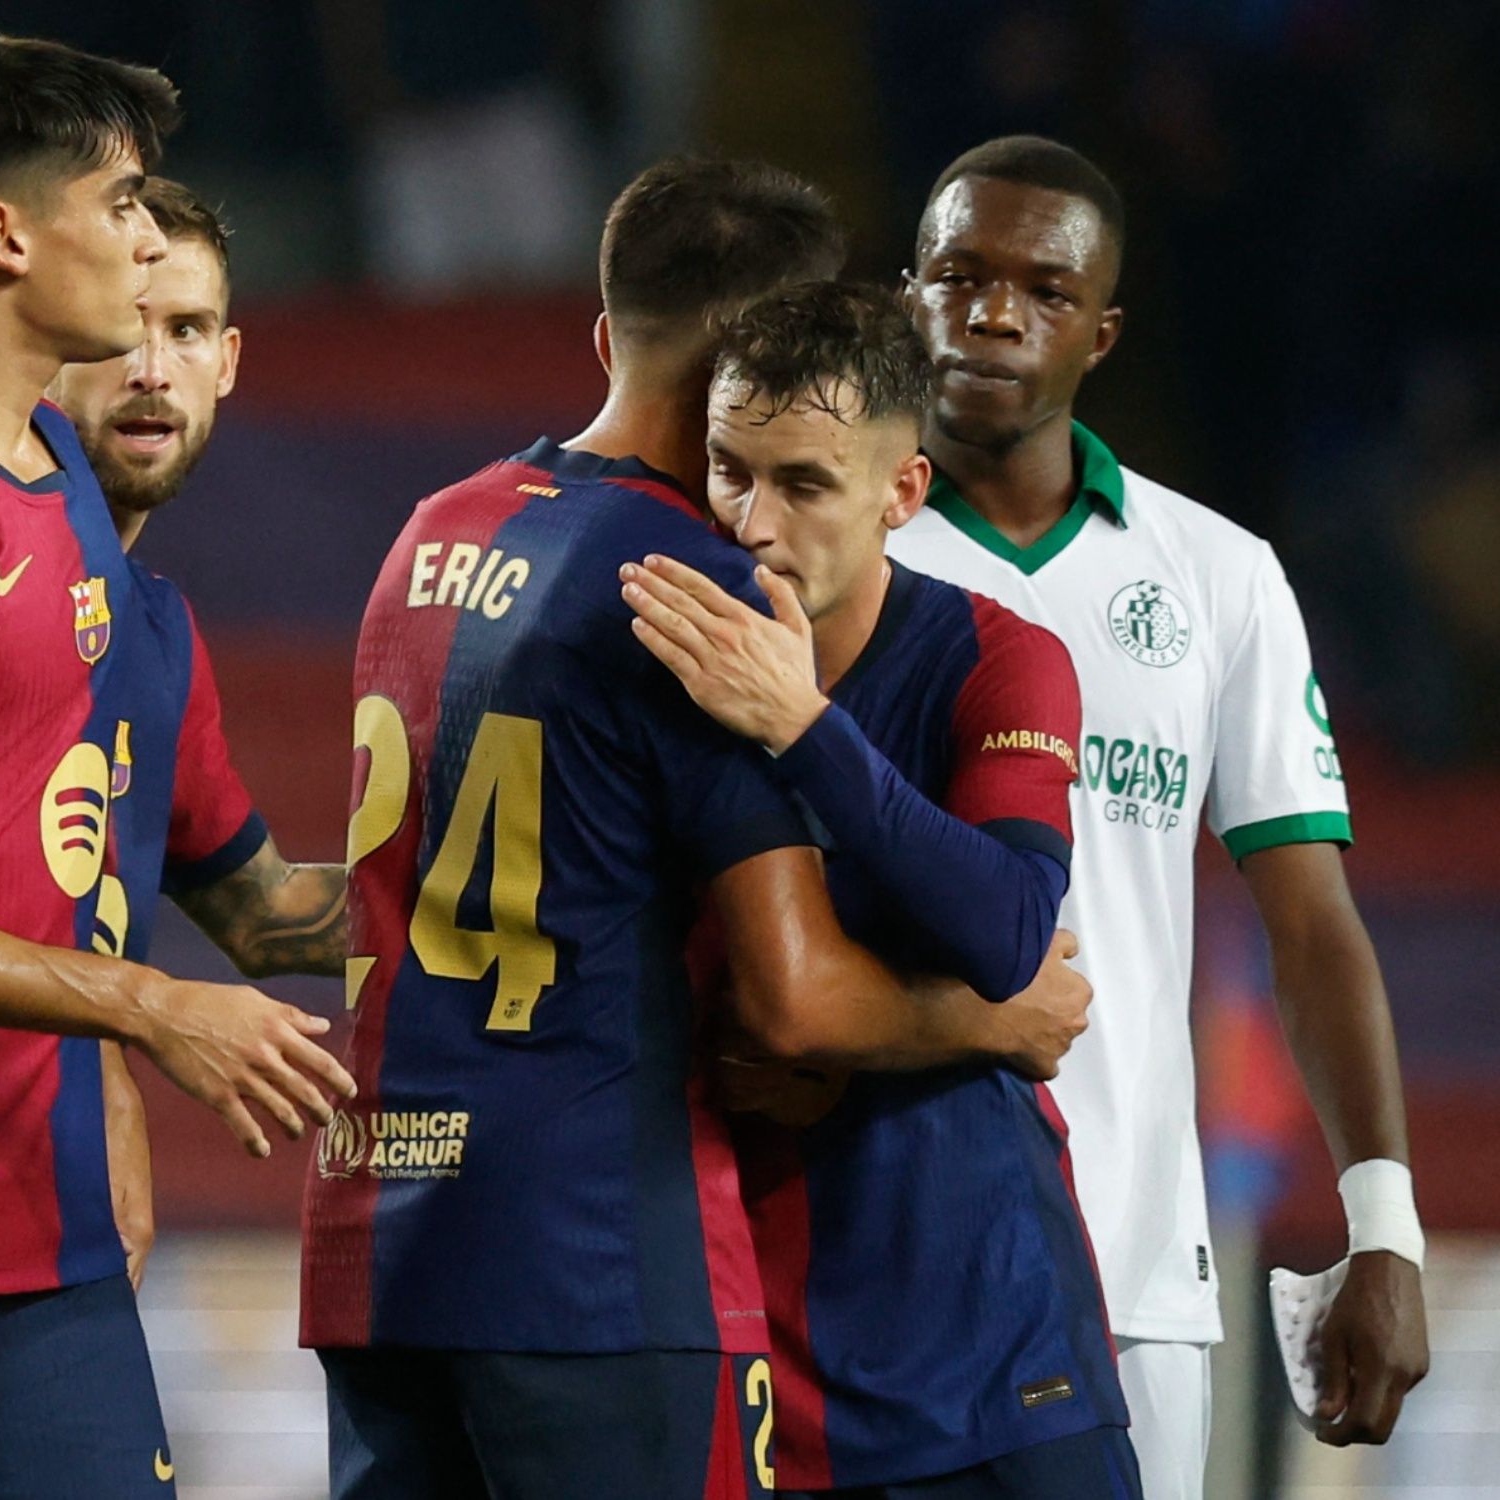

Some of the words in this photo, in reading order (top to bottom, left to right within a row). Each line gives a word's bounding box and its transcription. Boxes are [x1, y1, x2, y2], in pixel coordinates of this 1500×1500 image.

[407, 542, 530, 621] ERIC
[1113, 618, 1145, 658] GETAFE
[1073, 734, 1188, 811] OCASA
[345, 695, 557, 1031] 24
[371, 1111, 469, 1139] UNHCR
[368, 1139, 464, 1167] ACNUR
[368, 1168, 383, 1178] The
[384, 1168, 397, 1179] UN
[397, 1168, 429, 1181] Refugee
[430, 1167, 460, 1179] Agency
